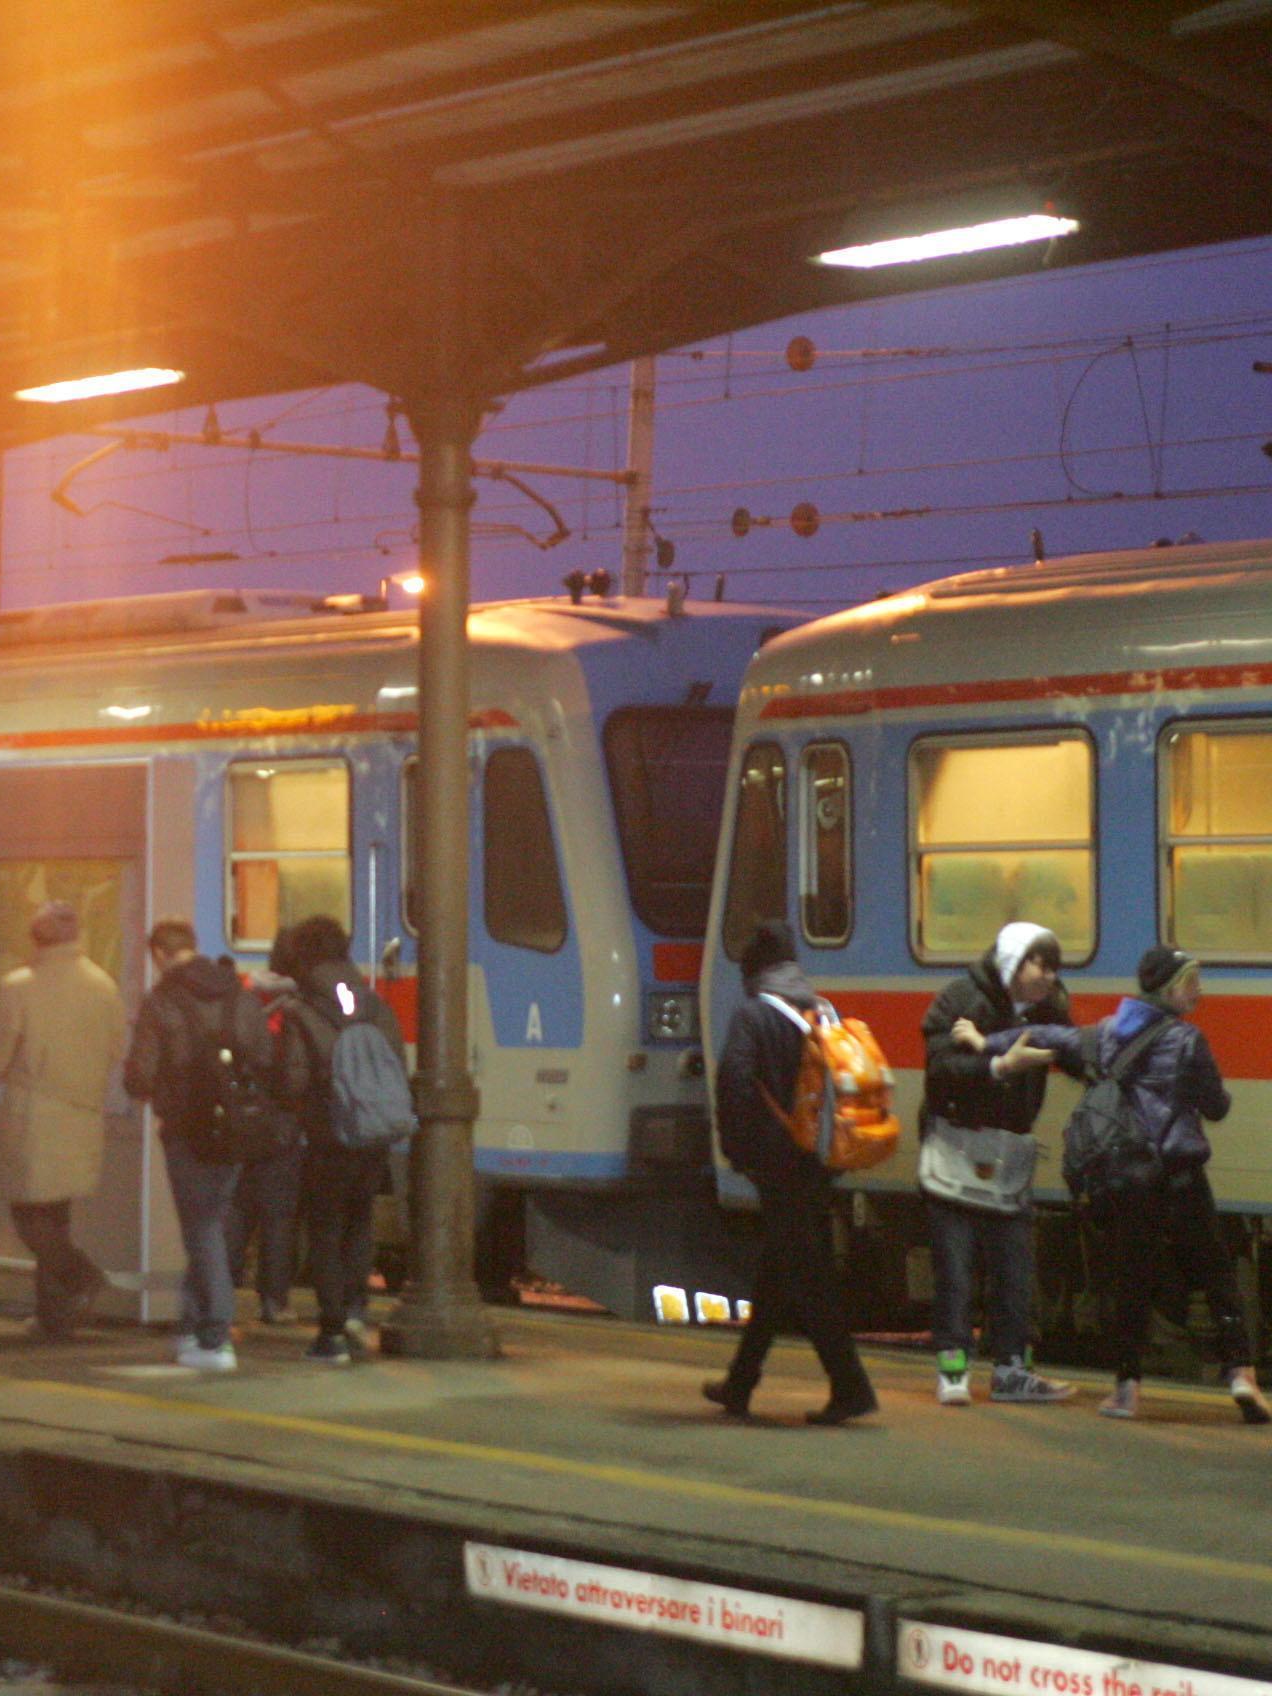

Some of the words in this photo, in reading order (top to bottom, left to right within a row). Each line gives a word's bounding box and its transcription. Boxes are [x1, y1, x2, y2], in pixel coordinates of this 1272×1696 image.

[503, 1559, 569, 1599] Vietato
[575, 1579, 701, 1624] attraversare
[707, 1595, 716, 1626] i
[720, 1598, 785, 1639] binari
[941, 1640, 974, 1676] Do
[982, 1656, 1022, 1684] not
[1030, 1664, 1093, 1696] cross
[1102, 1667, 1143, 1696] the
